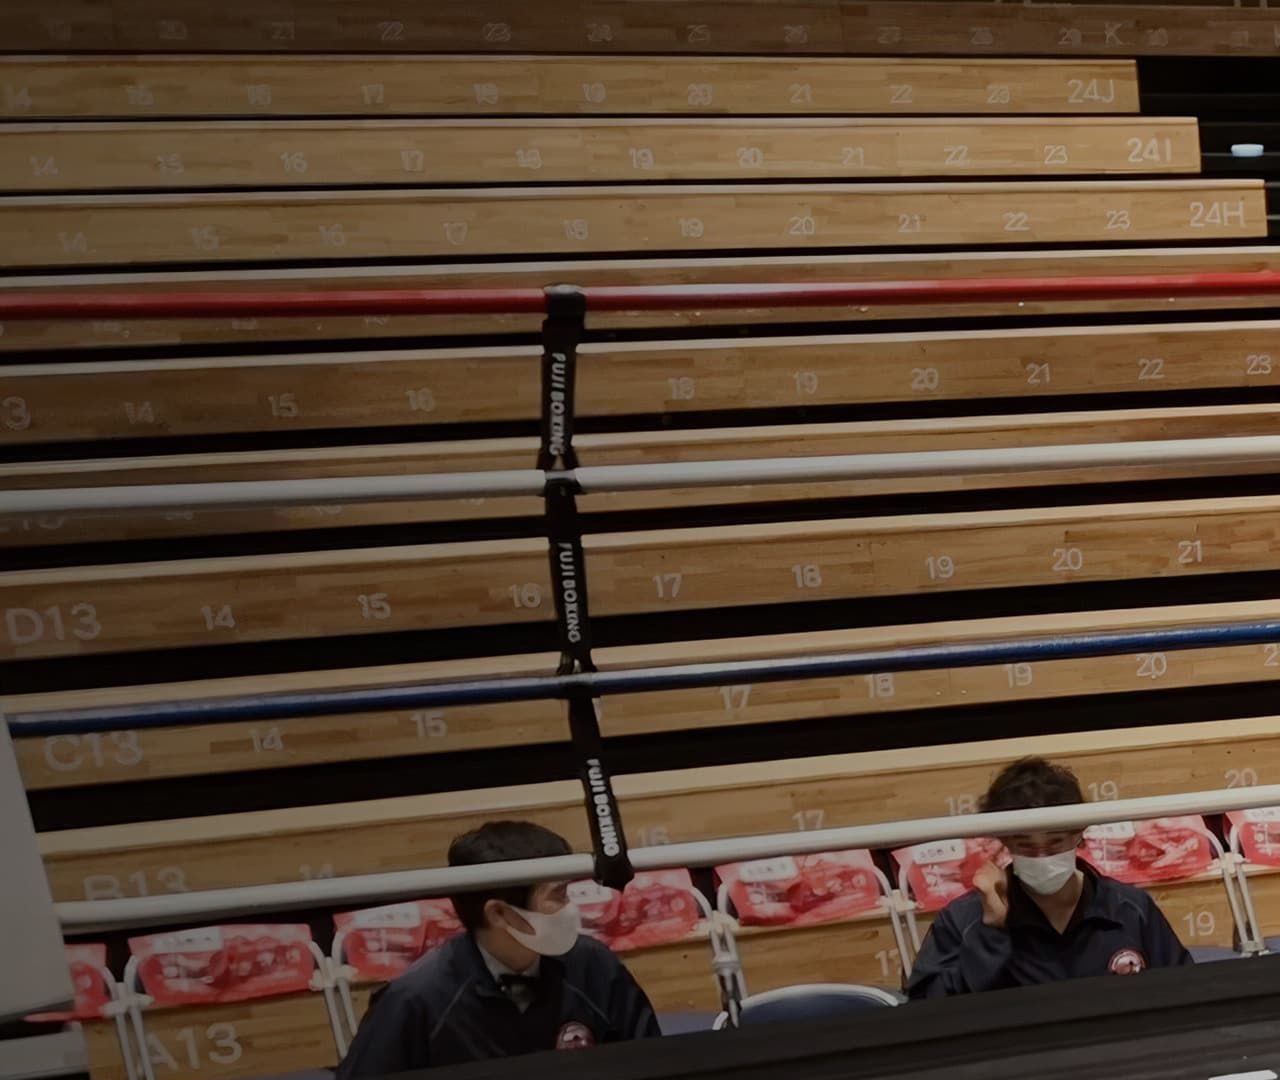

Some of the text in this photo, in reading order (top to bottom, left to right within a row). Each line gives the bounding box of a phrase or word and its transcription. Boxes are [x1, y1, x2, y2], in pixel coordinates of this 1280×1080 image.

[1104, 22, 1122, 45] K
[1067, 79, 1115, 103] 24J
[944, 144, 970, 166] 22
[1043, 145, 1068, 165] 23
[788, 215, 815, 236] 20
[1003, 212, 1030, 231] 22
[1103, 209, 1130, 230] 23
[1189, 201, 1245, 228] 24H
[268, 393, 298, 417] 15
[795, 371, 818, 394] 19
[911, 368, 939, 391] 20
[1025, 363, 1051, 385] 21
[1138, 358, 1166, 381] 22
[1246, 353, 1271, 375] 23
[551, 352, 566, 387] FUJI
[6, 602, 101, 645] D13
[202, 605, 236, 630] 14
[357, 593, 391, 619] 15
[508, 584, 541, 608] 16
[652, 573, 683, 598] 17
[792, 564, 822, 588] 18
[925, 555, 954, 579] 19
[1053, 547, 1083, 571] 20
[1178, 541, 1202, 563] 21
[248, 728, 283, 752] 14
[410, 710, 447, 738] 15
[864, 674, 895, 698] 18
[1005, 662, 1033, 687] 19
[1135, 653, 1168, 678] 20
[138, 1023, 243, 1075] A13
[1182, 911, 1215, 936] 19
